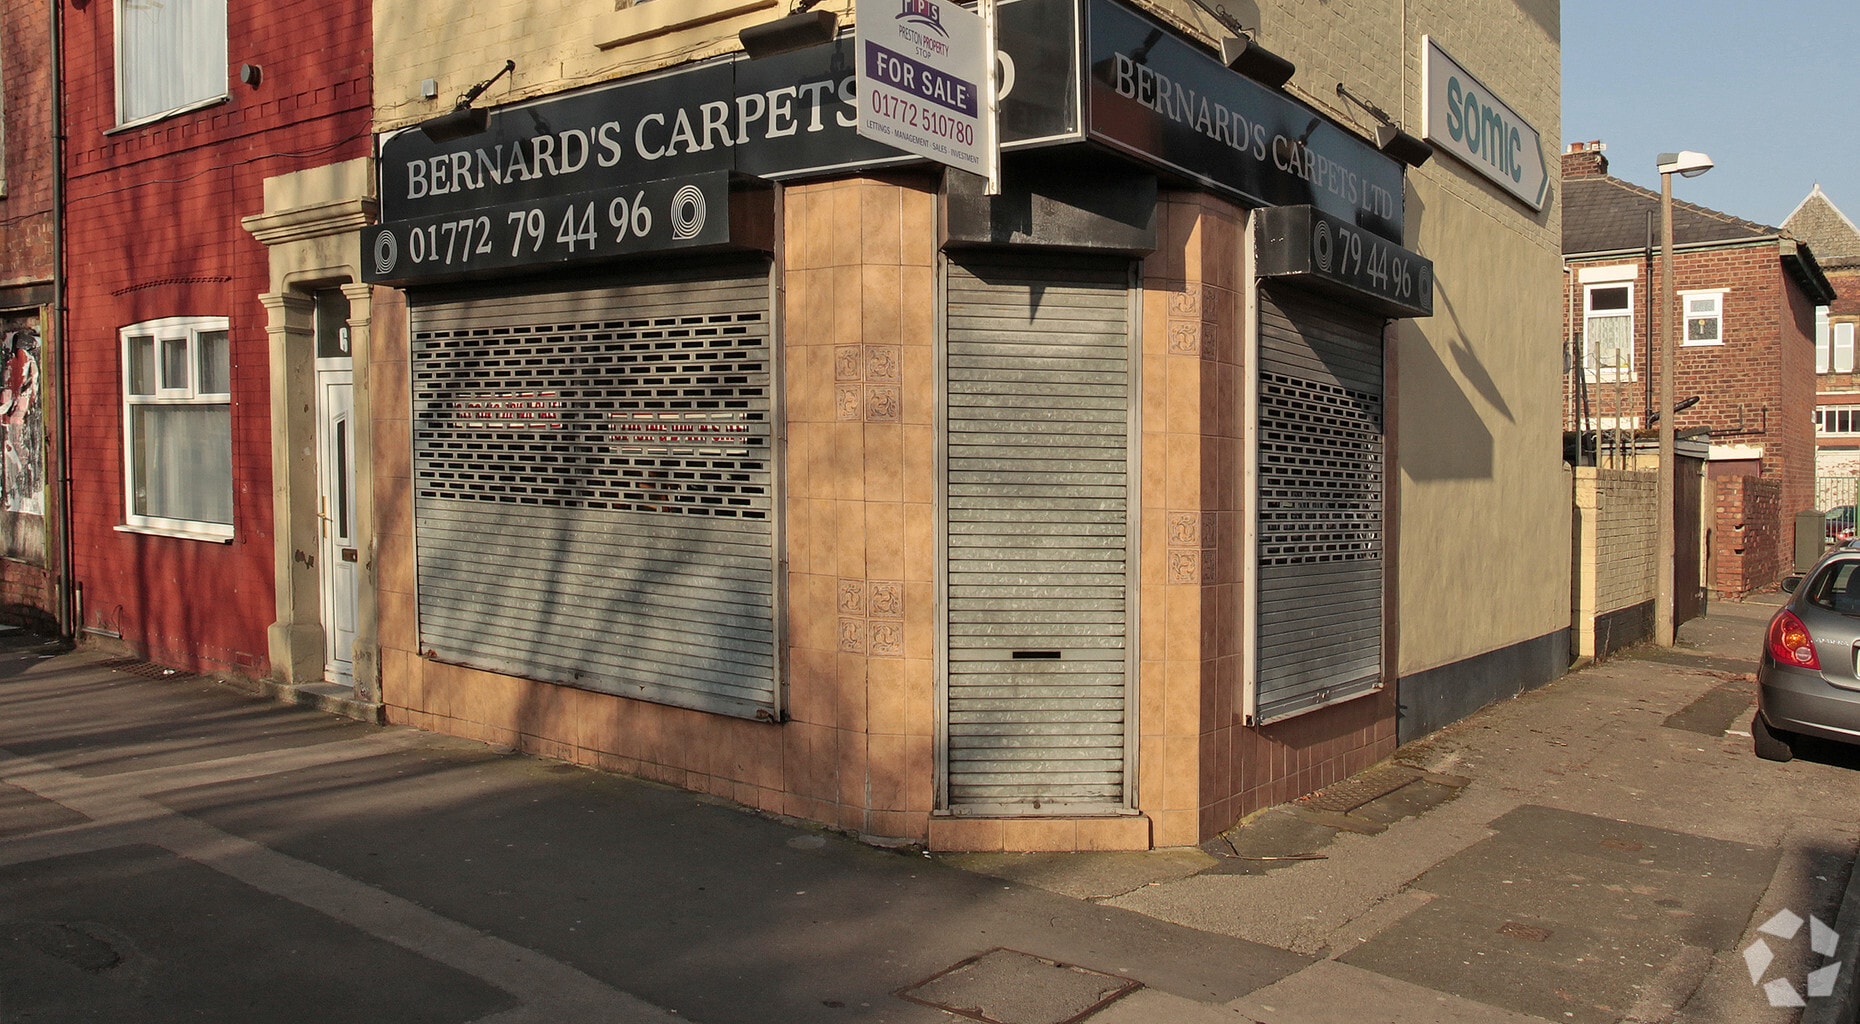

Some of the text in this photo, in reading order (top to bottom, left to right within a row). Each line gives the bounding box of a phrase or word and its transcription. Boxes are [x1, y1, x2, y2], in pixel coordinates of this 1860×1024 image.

[898, 25, 950, 57] PRESTON PROPERTY
[915, 46, 931, 60] STOP
[876, 51, 915, 90] FOR
[921, 70, 967, 109] SALE
[406, 75, 857, 200] BERNARD'S CARPETS
[866, 119, 980, 165] LETTINGS MANAGEMENT SALES INVESTMENT
[872, 89, 974, 147] 01772 510780
[1114, 52, 1393, 221] BERNARD'S CARPETS LTD
[409, 190, 652, 265] 01772 79 44 96
[1339, 229, 1412, 298] 79 44 96
